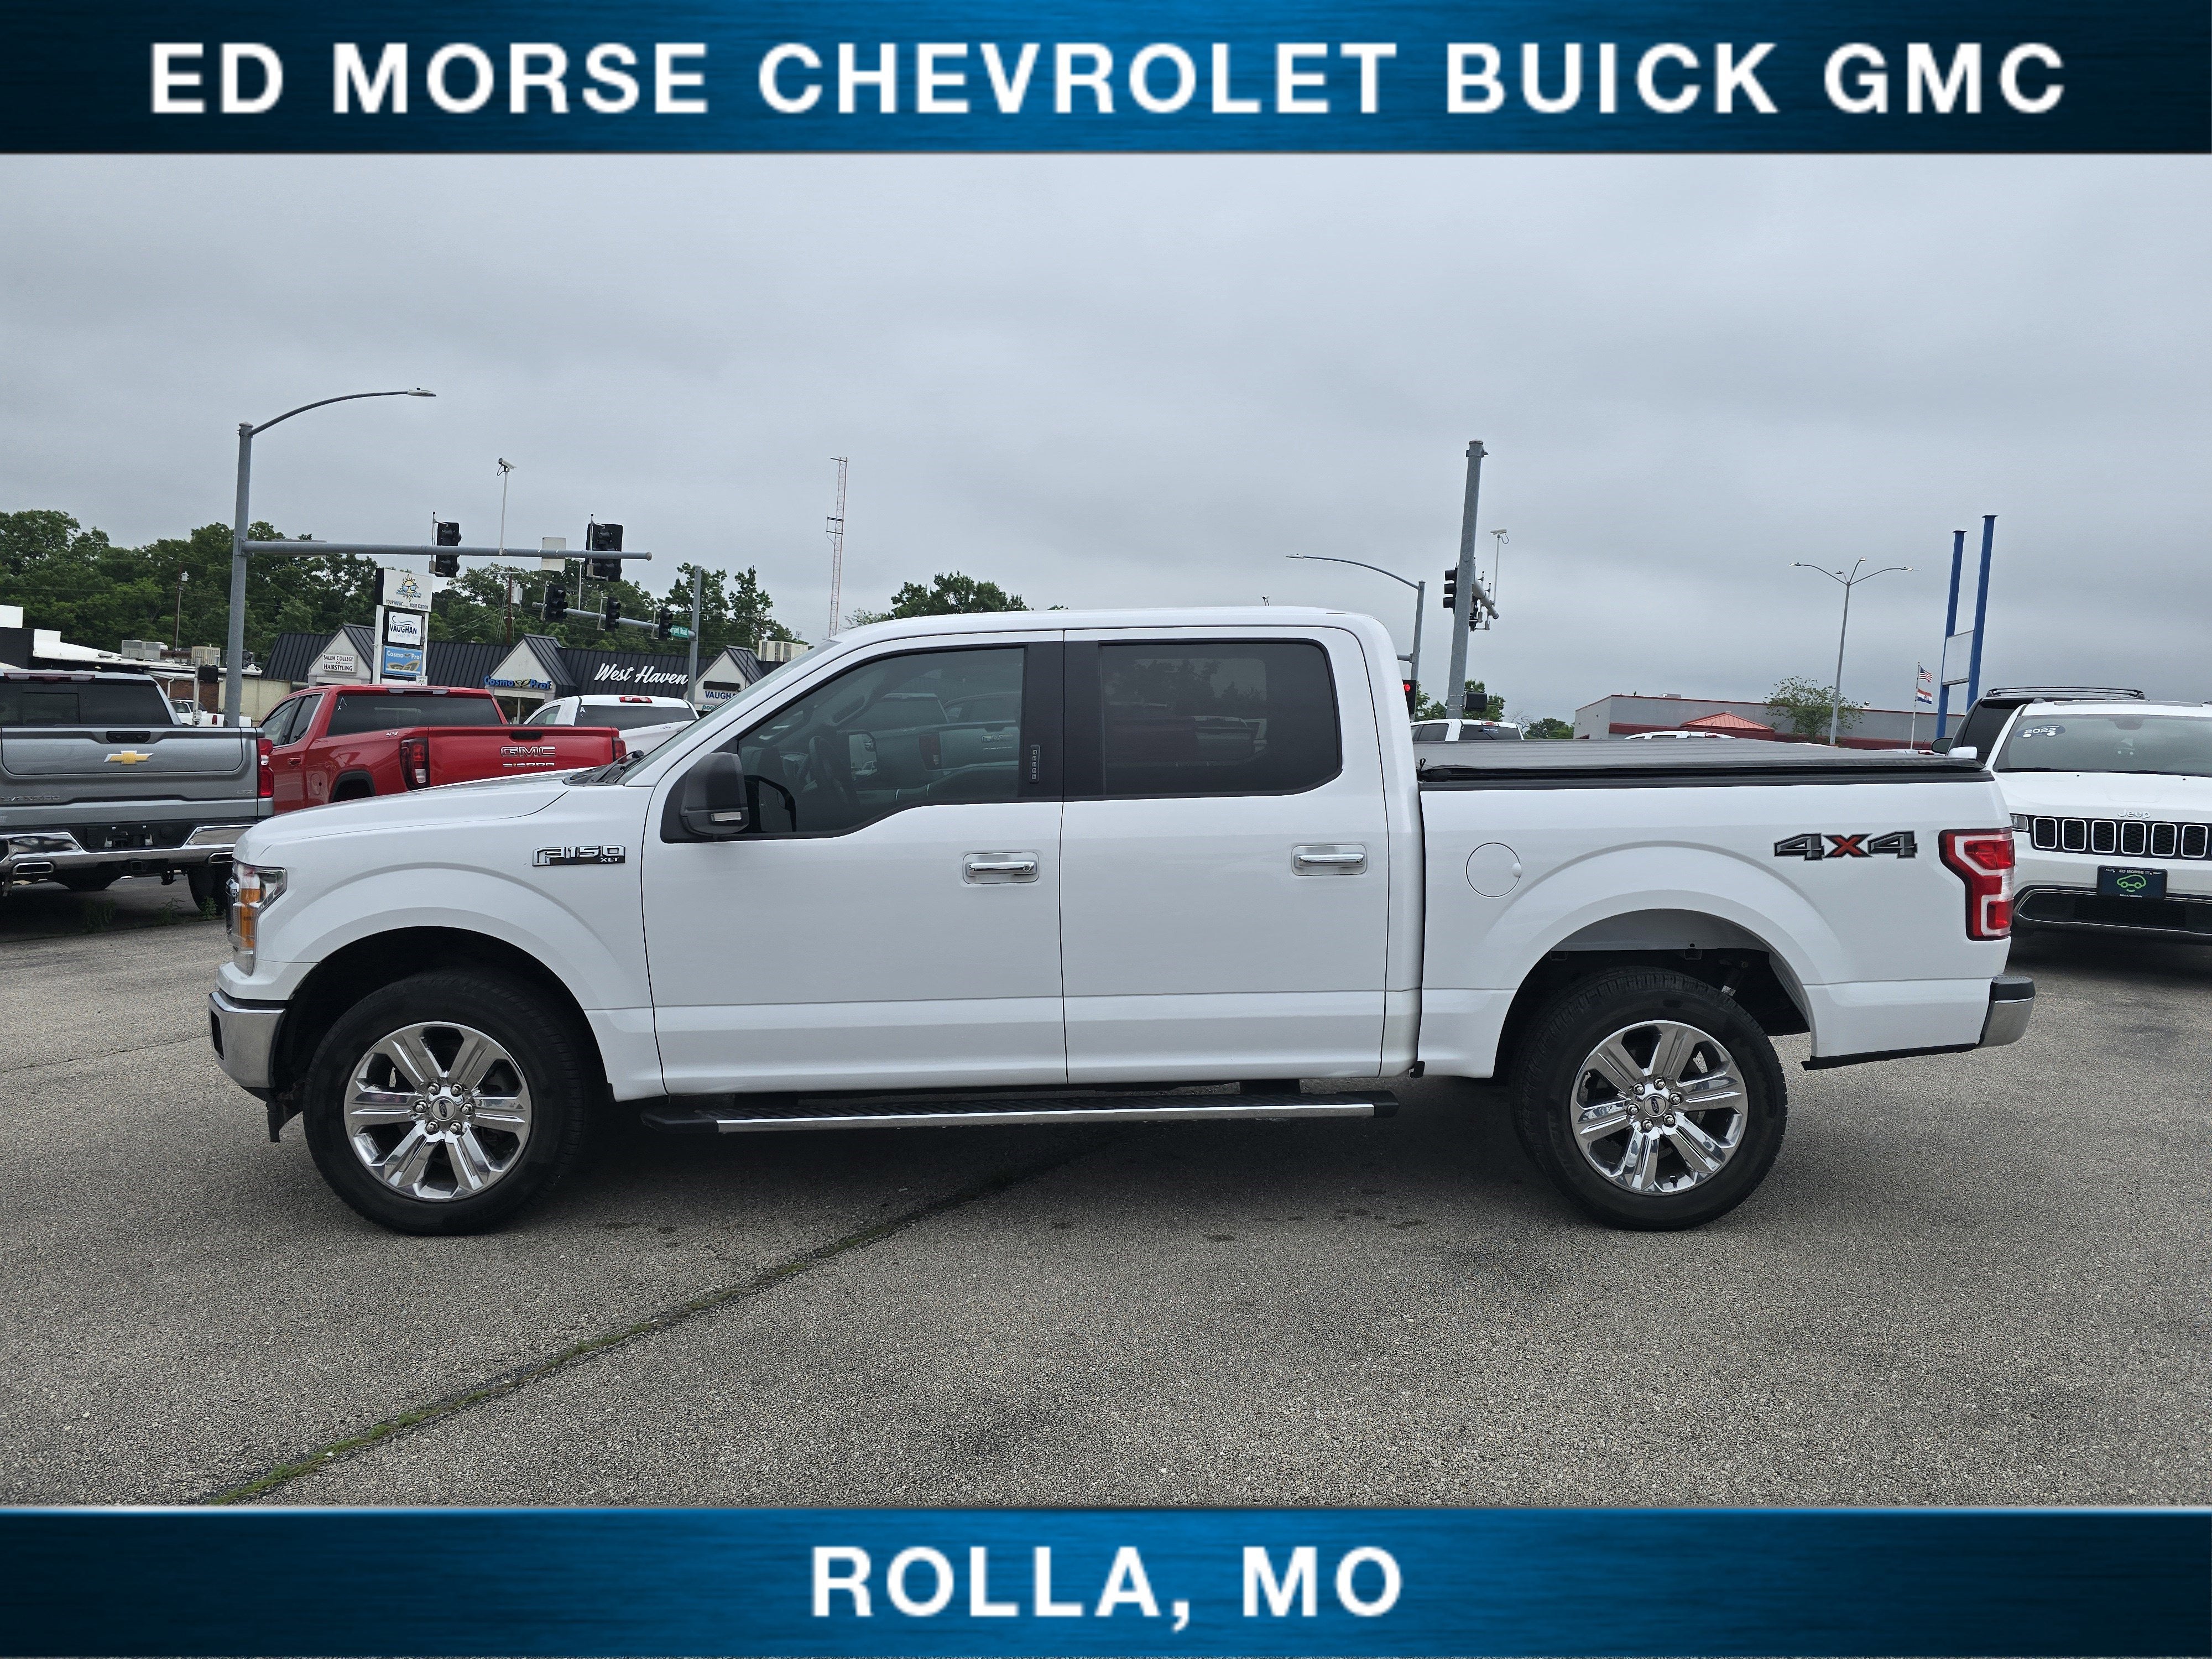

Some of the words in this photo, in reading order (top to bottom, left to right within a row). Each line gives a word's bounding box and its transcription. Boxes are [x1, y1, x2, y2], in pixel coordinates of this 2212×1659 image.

[389, 623, 417, 635] VAUGHAN
[594, 663, 634, 681] West
[634, 665, 688, 685] Haven
[483, 675, 515, 687] Cosmo
[529, 679, 552, 690] Prof
[705, 690, 737, 700] VAUGH
[500, 745, 556, 758] GMC
[2117, 808, 2151, 820] Jeep
